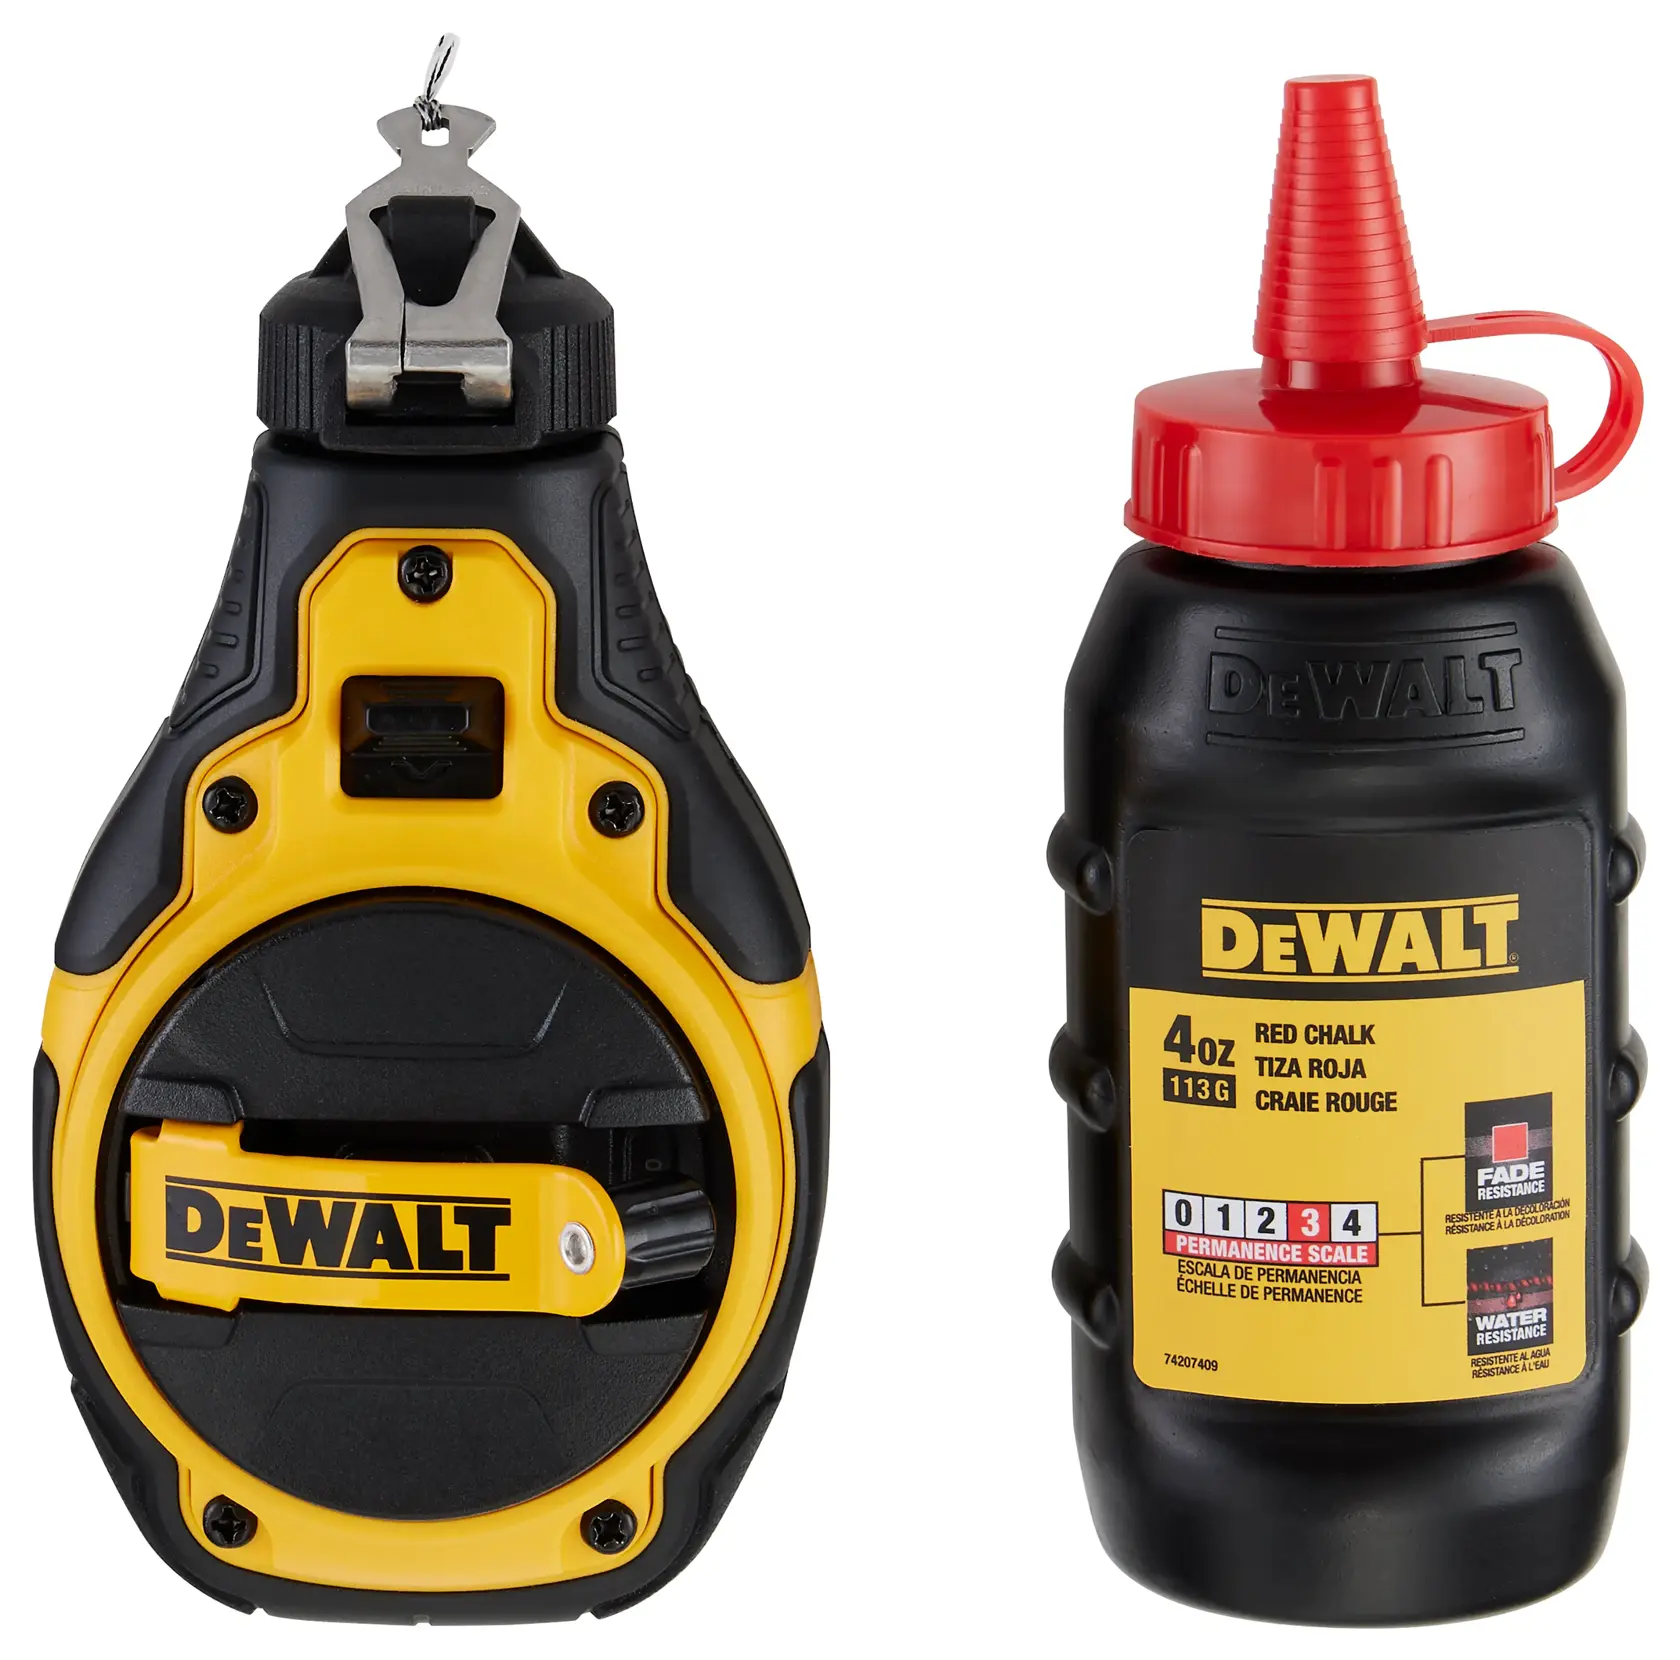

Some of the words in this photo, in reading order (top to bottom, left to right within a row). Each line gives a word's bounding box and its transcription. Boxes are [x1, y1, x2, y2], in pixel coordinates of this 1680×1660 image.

[1255, 1022, 1297, 1044] RED
[1304, 1024, 1376, 1045] CHALK
[1254, 1056, 1302, 1078] TIZA
[1308, 1058, 1367, 1079] ROJA
[1255, 1090, 1319, 1112] CRAIE
[1326, 1091, 1397, 1113] ROUGE
[1477, 1160, 1545, 1186] FADE
[1477, 1180, 1545, 1201] RESISTANCE
[1175, 1199, 1192, 1226] 0
[1217, 1203, 1230, 1231] 1
[1257, 1206, 1275, 1234] 2
[1301, 1208, 1320, 1237] 3
[1342, 1209, 1362, 1236] 4
[1445, 1210, 1494, 1223] RESISTENTE
[1503, 1208, 1514, 1217] LA
[1504, 1219, 1514, 1229] LA
[1176, 1234, 1302, 1262] PERMANENCE
[1308, 1244, 1368, 1263] SCALE
[1178, 1259, 1230, 1279] ESCALA
[1235, 1265, 1252, 1281] DE
[1258, 1267, 1362, 1284] PERMANENCIA
[1177, 1275, 1236, 1298] ÉCHELLE
[1241, 1284, 1259, 1300] DE
[1264, 1287, 1362, 1303] PERMANENCE
[1475, 1307, 1547, 1331] WATER
[1476, 1323, 1547, 1345] RESISTANCE
[1164, 1353, 1218, 1371] 74207409
[1471, 1353, 1518, 1367] RESISTENTE
[1519, 1351, 1529, 1361] AL
[1530, 1348, 1550, 1360] AGUA
